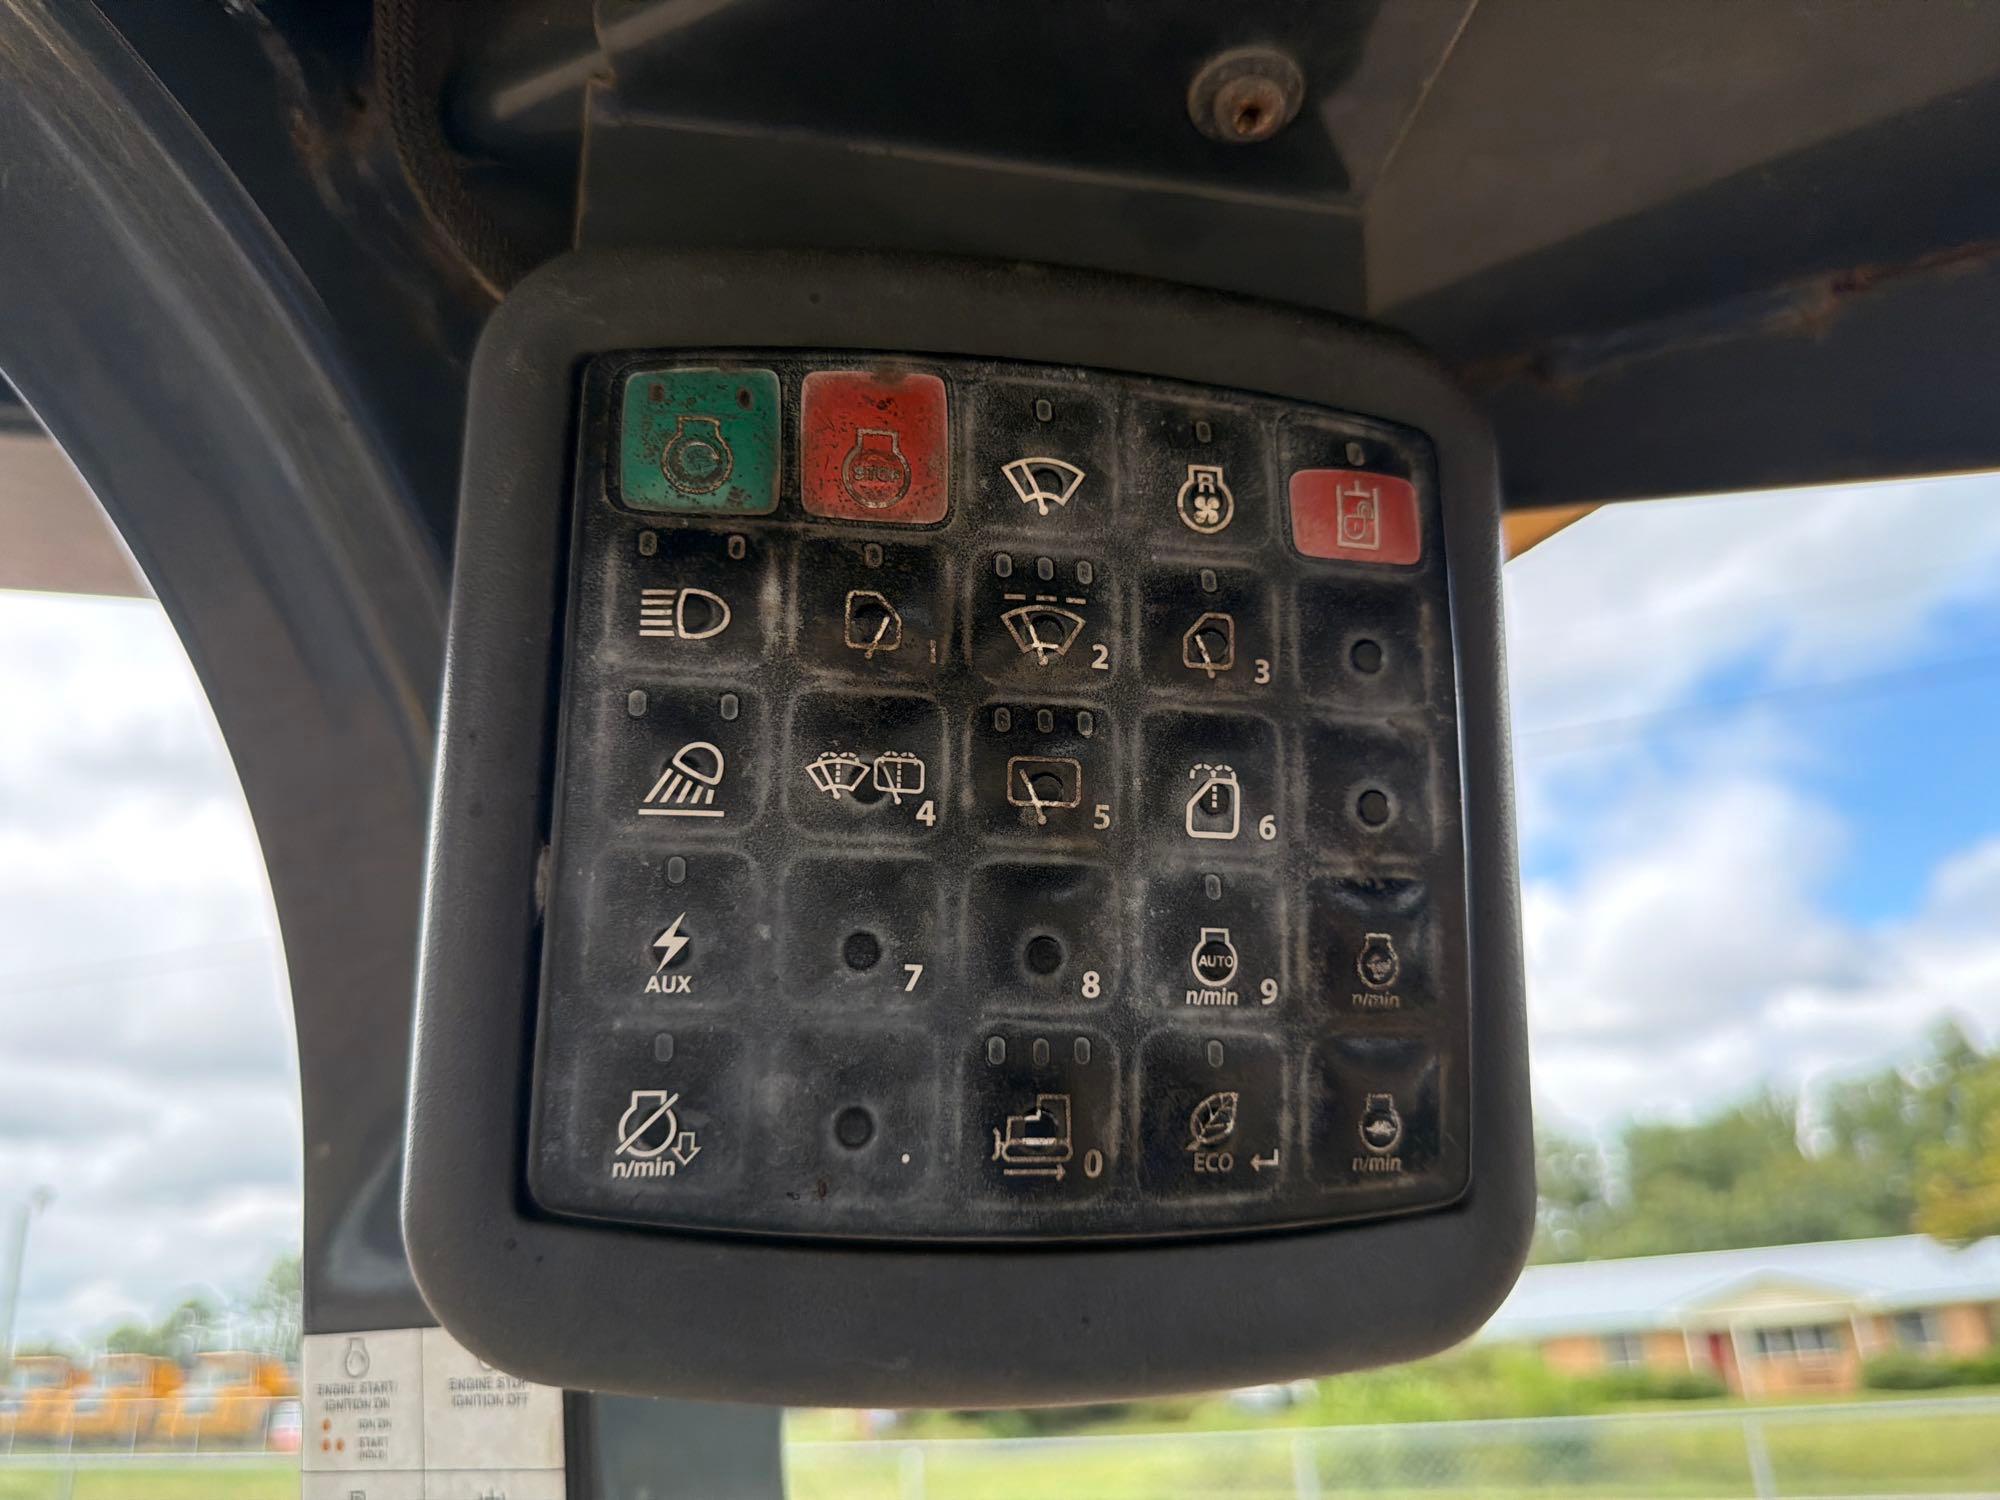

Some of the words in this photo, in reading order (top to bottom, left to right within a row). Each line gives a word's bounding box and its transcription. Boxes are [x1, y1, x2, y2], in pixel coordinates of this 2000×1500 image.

[1197, 472, 1215, 493] R
[1091, 644, 1110, 670] 2
[1254, 659, 1271, 684] 3
[915, 800, 937, 827] 4
[1093, 805, 1111, 830] 5
[1258, 814, 1277, 840] 6
[1198, 954, 1234, 969] AUTO
[643, 975, 692, 994] AUX
[903, 964, 923, 992] 7
[1081, 971, 1100, 998] 8
[1185, 987, 1239, 1006] n/min
[1260, 978, 1279, 1004] 9
[1352, 991, 1400, 1008] n/min
[612, 1157, 676, 1179] n/min
[1084, 1149, 1103, 1179] 0
[1193, 1153, 1234, 1173] ECO
[1352, 1153, 1402, 1172] n/min
